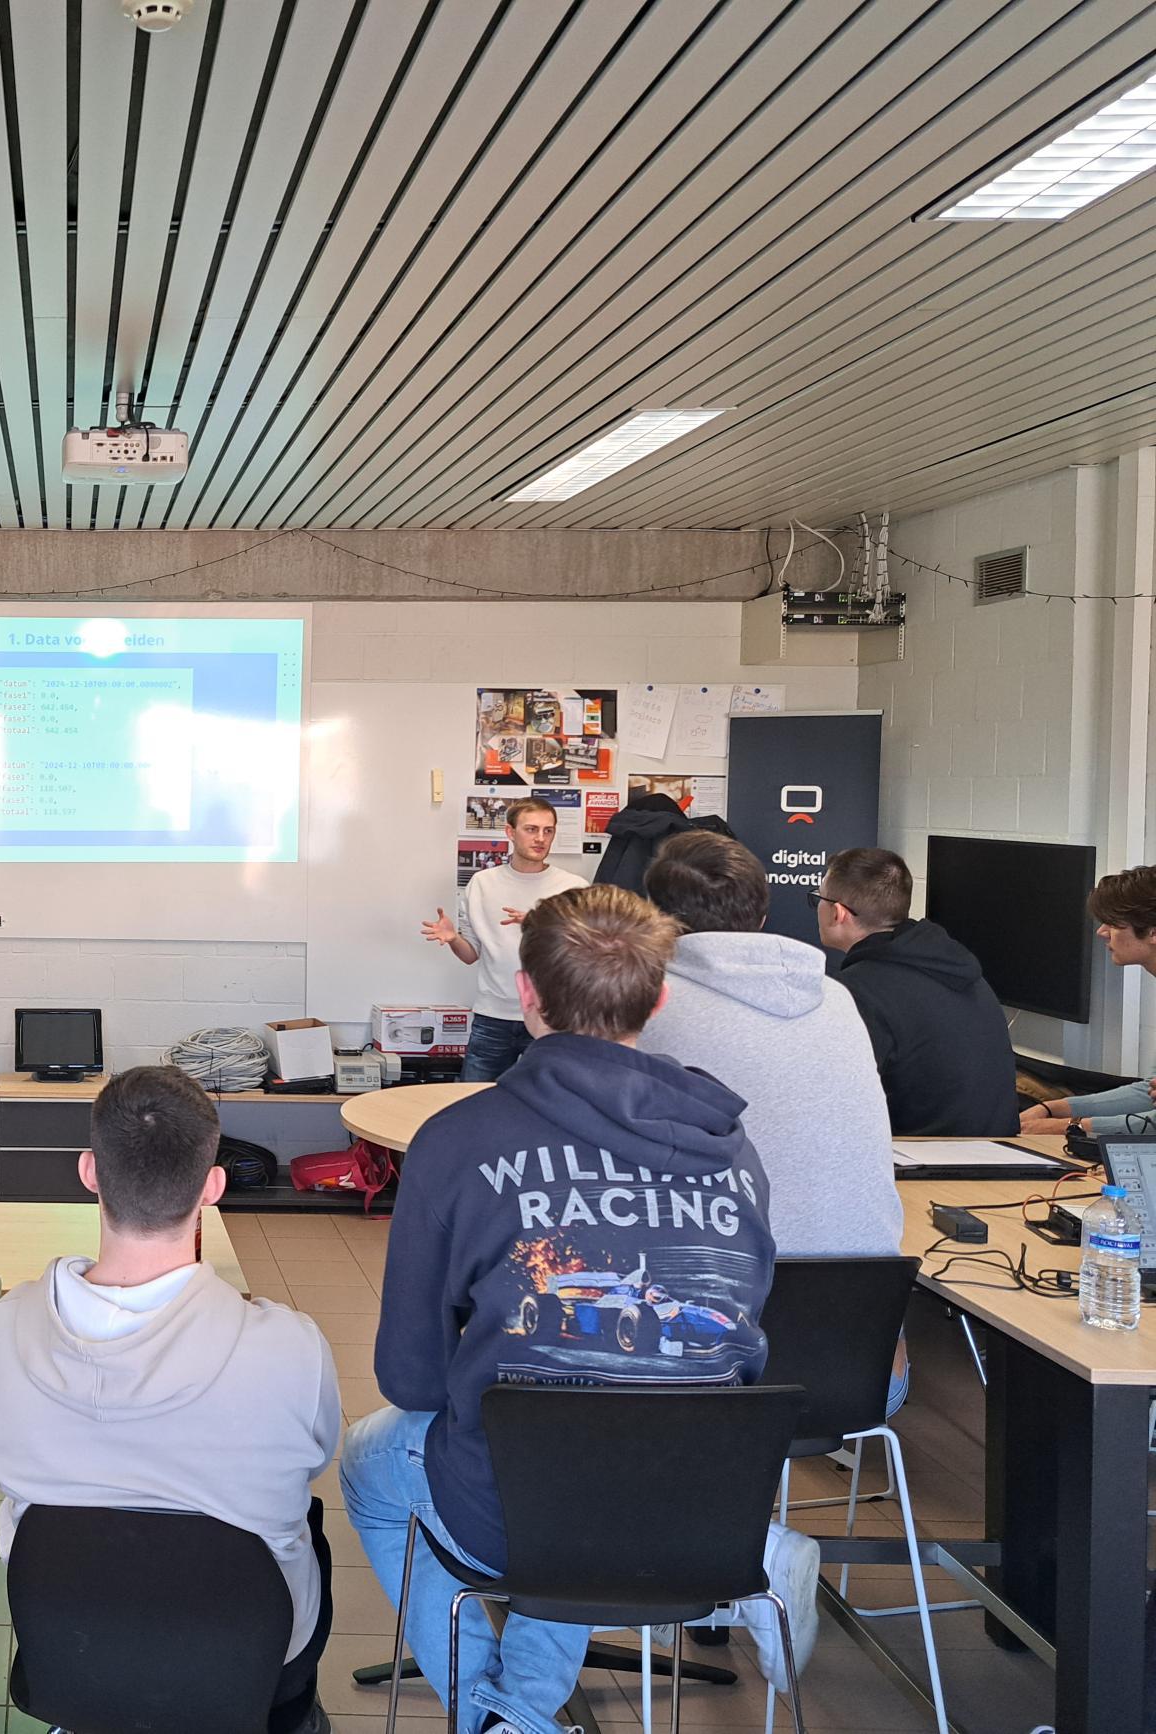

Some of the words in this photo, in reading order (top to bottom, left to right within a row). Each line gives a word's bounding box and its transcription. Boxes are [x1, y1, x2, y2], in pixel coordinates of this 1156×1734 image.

[9, 633, 20, 646] 1.
[25, 633, 61, 646] Data
[772, 849, 826, 868] digital
[478, 1145, 757, 1206] WILLMS
[518, 1187, 740, 1237] RACING
